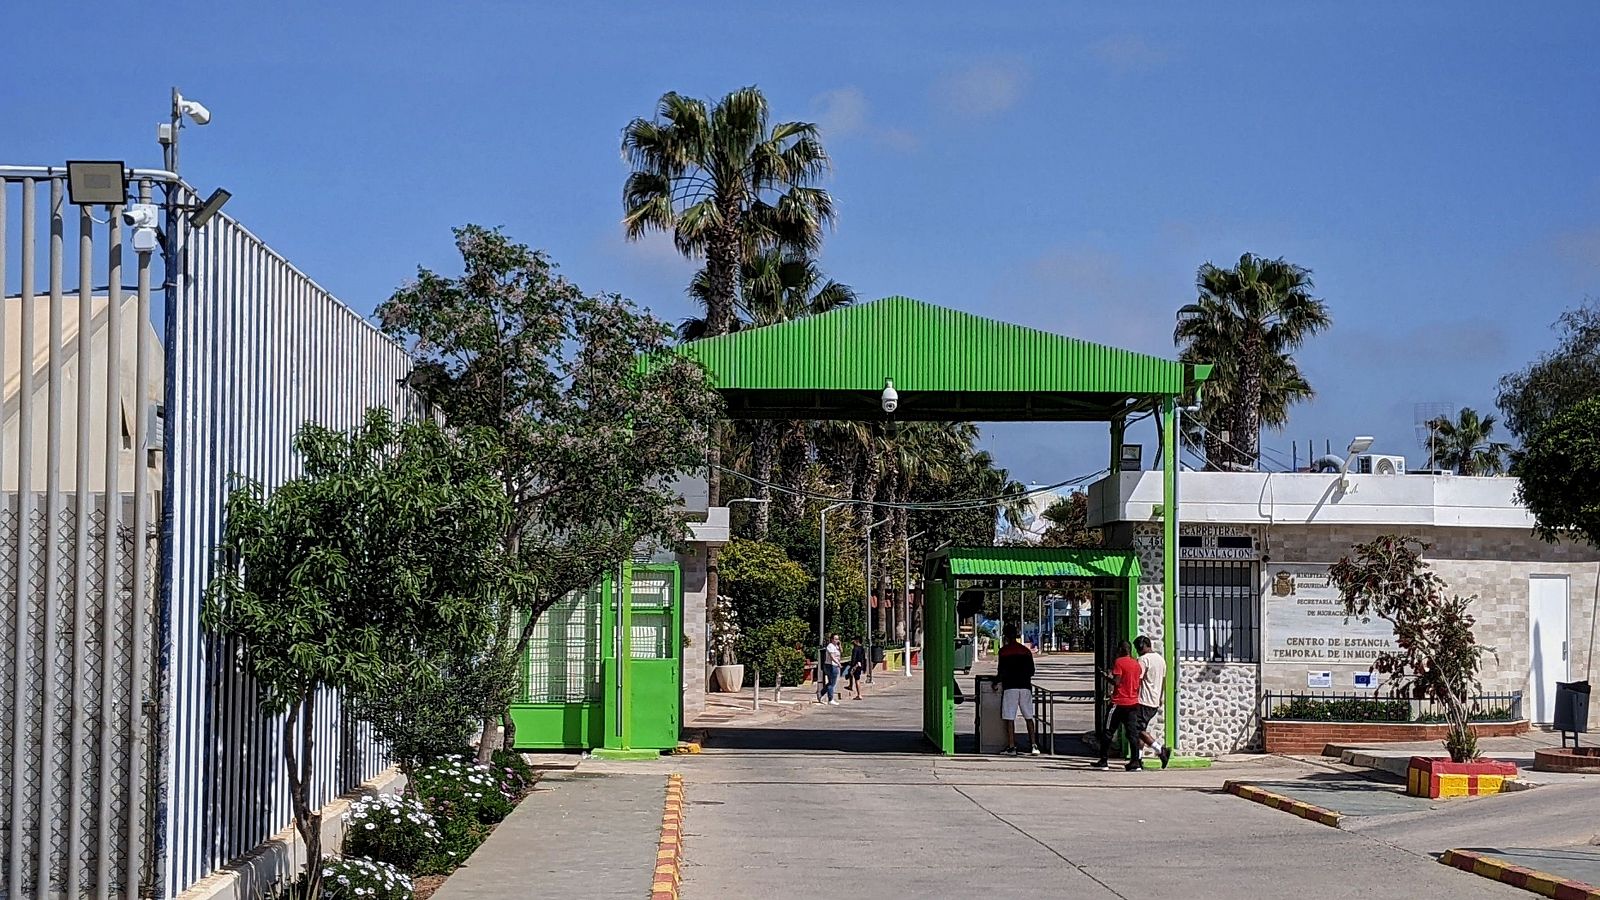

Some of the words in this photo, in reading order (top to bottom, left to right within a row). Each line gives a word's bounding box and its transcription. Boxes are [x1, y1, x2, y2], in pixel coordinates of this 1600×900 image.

[1204, 537, 1216, 547] DE
[1181, 548, 1250, 558] RCUNVALACION
[1286, 637, 1325, 646] CENTRO
[1328, 638, 1341, 646] DE
[1344, 638, 1390, 647] ESTANCIA
[1273, 649, 1324, 658] TEMPORAL
[1327, 649, 1340, 658] DE
[1343, 649, 1408, 659] INMIGRTES
